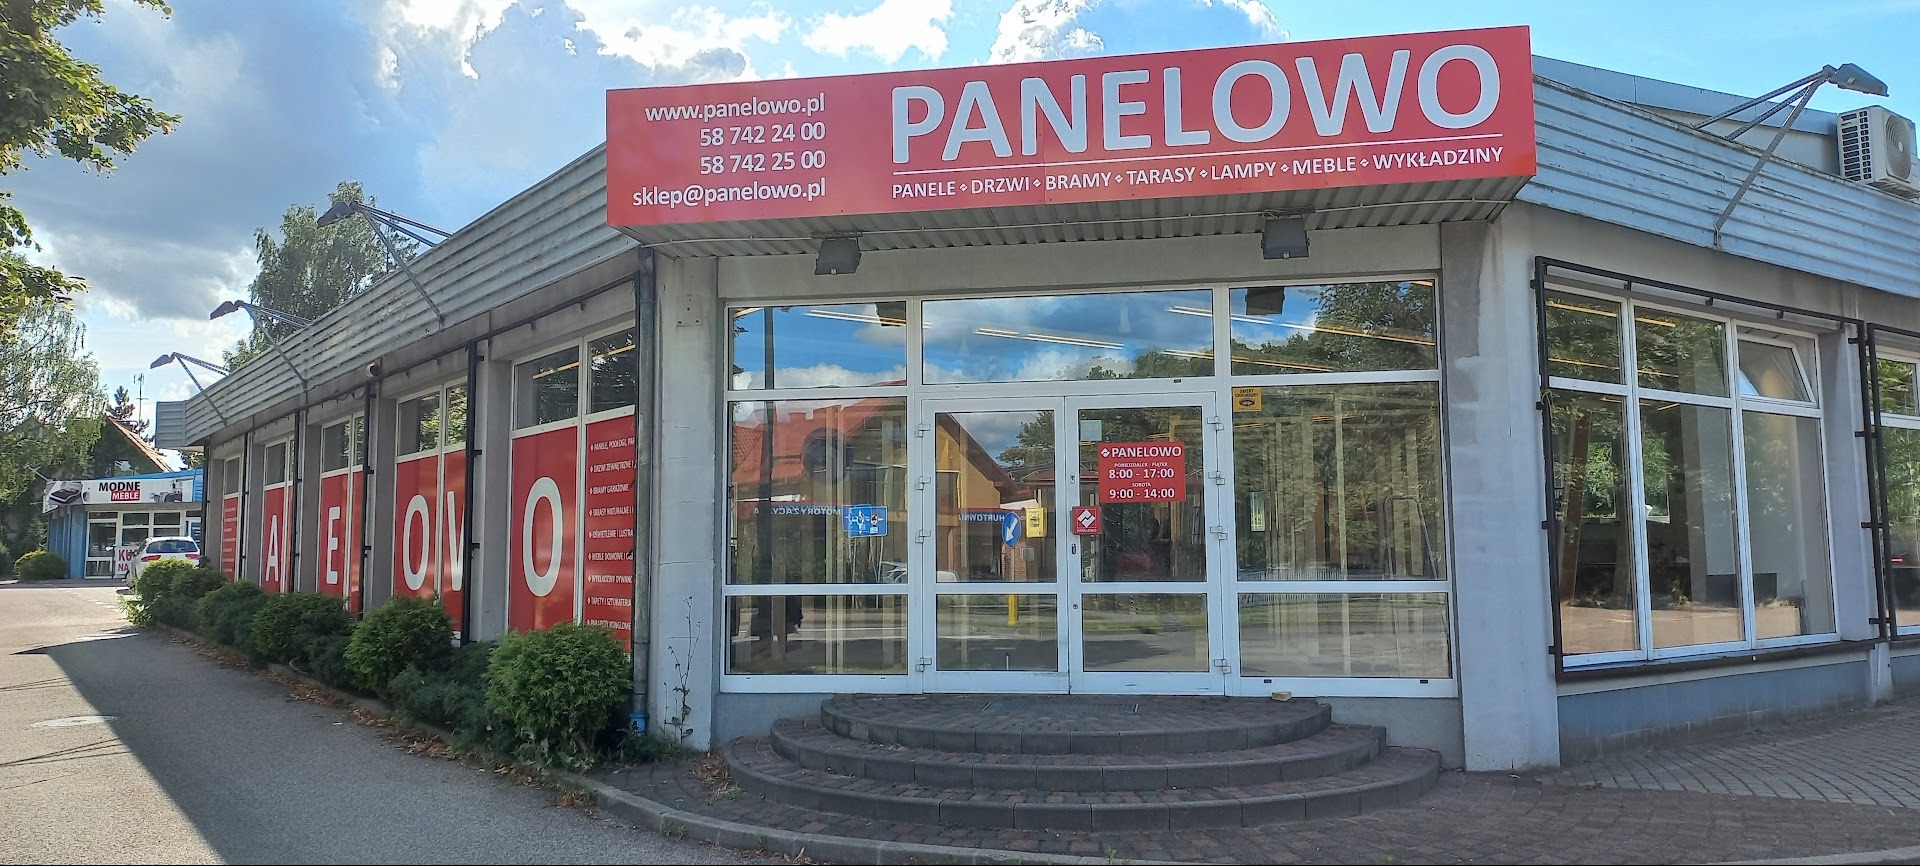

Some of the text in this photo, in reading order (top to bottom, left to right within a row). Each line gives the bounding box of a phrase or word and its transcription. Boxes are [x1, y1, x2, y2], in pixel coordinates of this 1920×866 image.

[644, 92, 826, 123] www.panelowo.pl
[892, 44, 1502, 164] PANELOWO
[700, 121, 826, 147] 58 742 24 00
[700, 149, 826, 175] 58 742 25 00
[892, 146, 1503, 199] PANELE DRZWI BRAMY TARASY LAMPY MEBLE WYKŁADZINY
[632, 176, 826, 209] sklep@panelowo.pl
[1111, 446, 1182, 458] PANELOWO
[98, 481, 141, 492] MODNE
[1109, 469, 1133, 479] 8:00
[1143, 468, 1174, 478] 17:00
[111, 491, 139, 501] MEBLE
[1109, 489, 1134, 499] 9:00
[1143, 488, 1175, 498] 14:00
